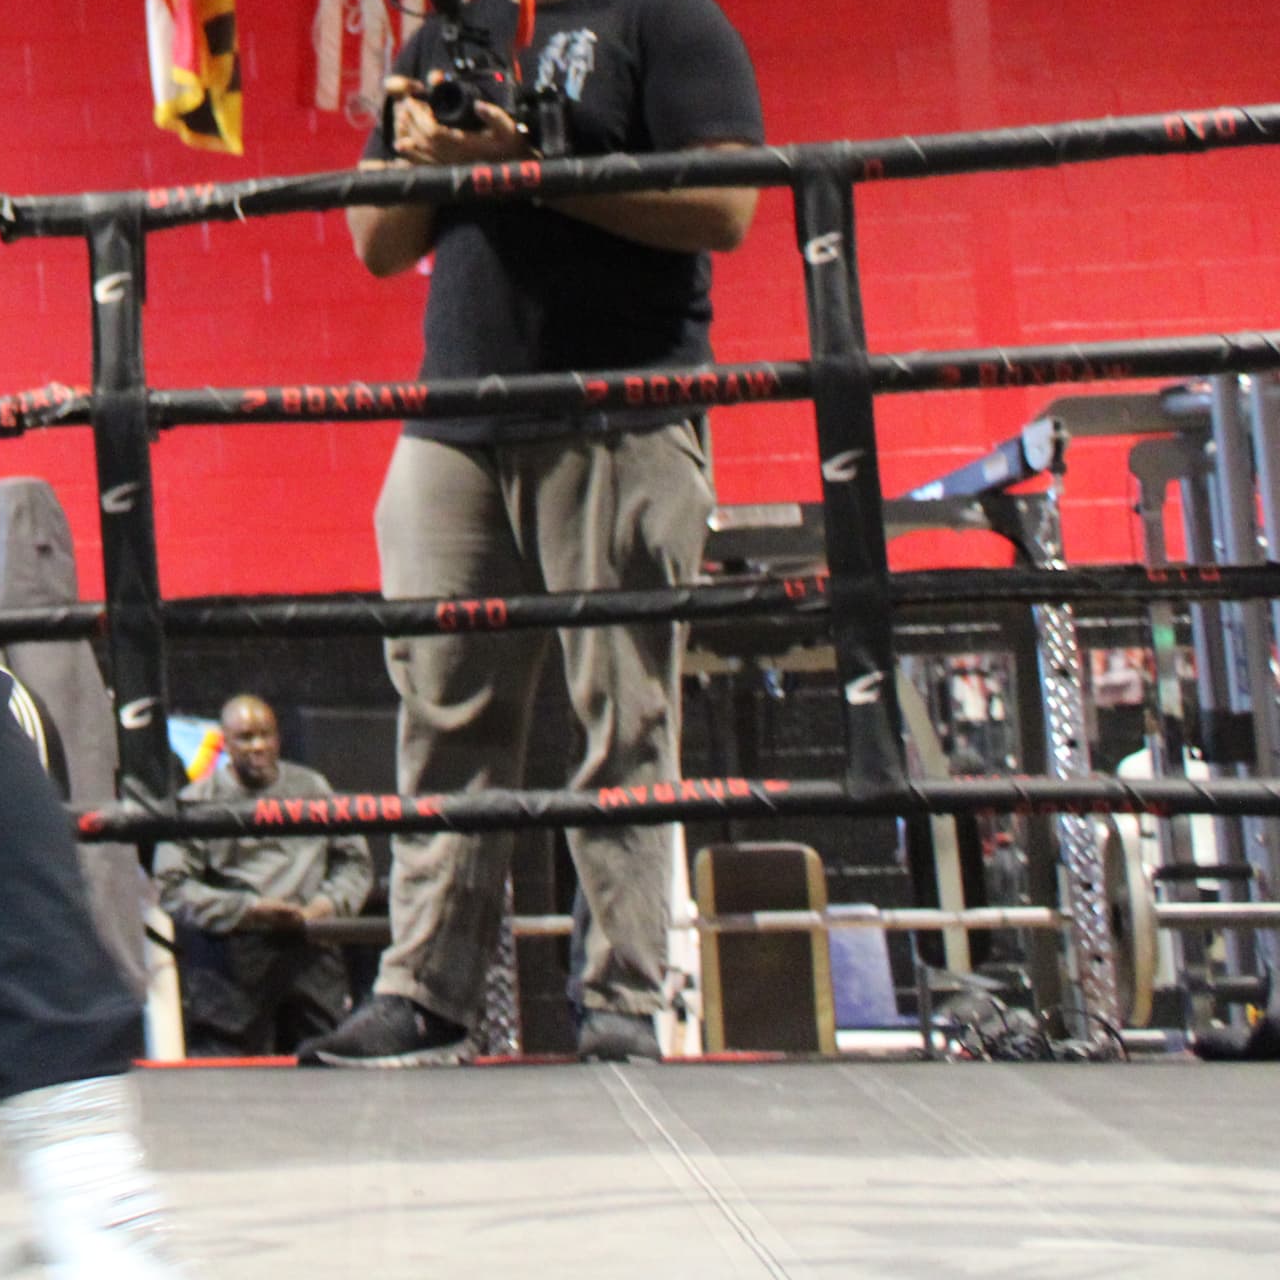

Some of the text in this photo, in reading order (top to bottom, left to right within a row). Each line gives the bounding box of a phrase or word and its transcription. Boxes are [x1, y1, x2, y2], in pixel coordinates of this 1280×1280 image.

[281, 385, 428, 414] BOXRAW
[435, 599, 507, 632] GTD
[255, 795, 402, 824] BOXRAW
